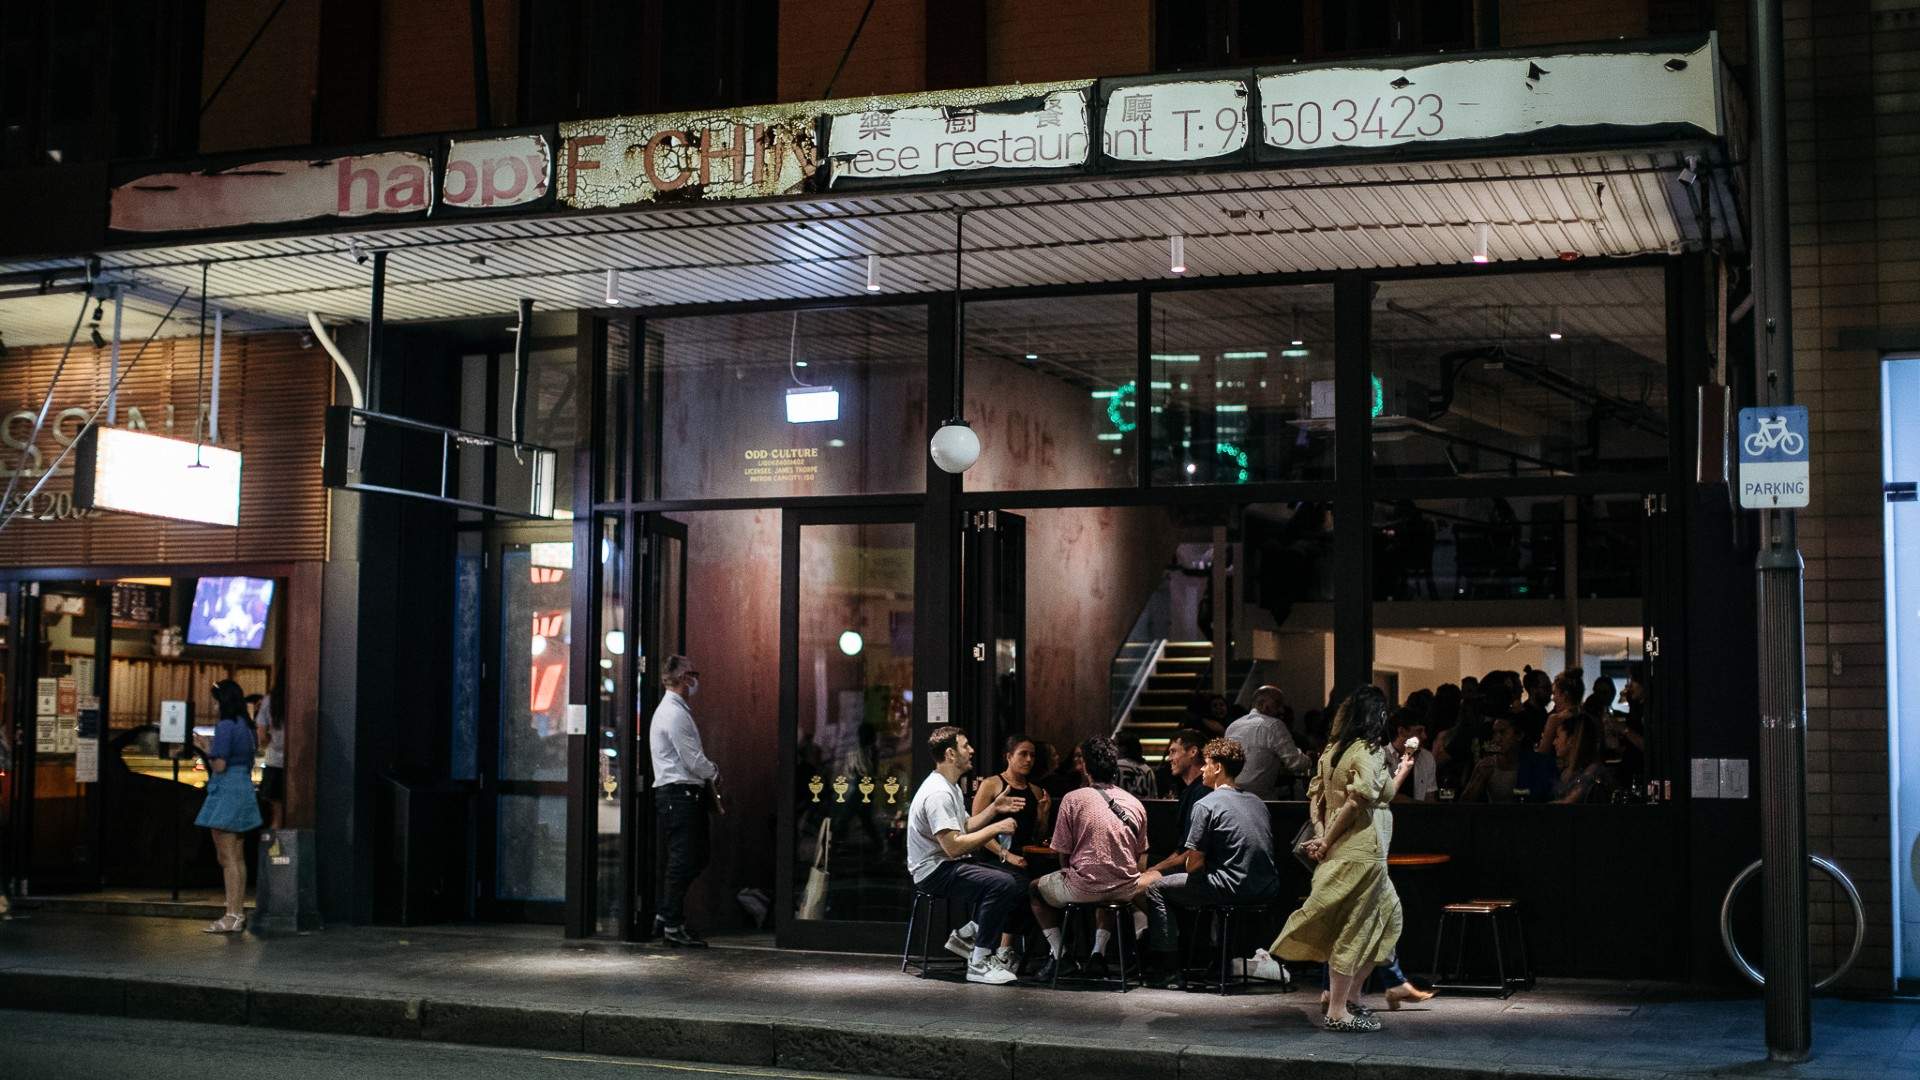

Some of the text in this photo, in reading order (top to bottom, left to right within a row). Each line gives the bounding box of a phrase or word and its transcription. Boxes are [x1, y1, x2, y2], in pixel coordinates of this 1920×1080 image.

[1215, 101, 1323, 148] 950
[1331, 93, 1445, 142] 3423
[744, 447, 818, 460] ODD CULTURE
[1745, 482, 1804, 495] PARKING
